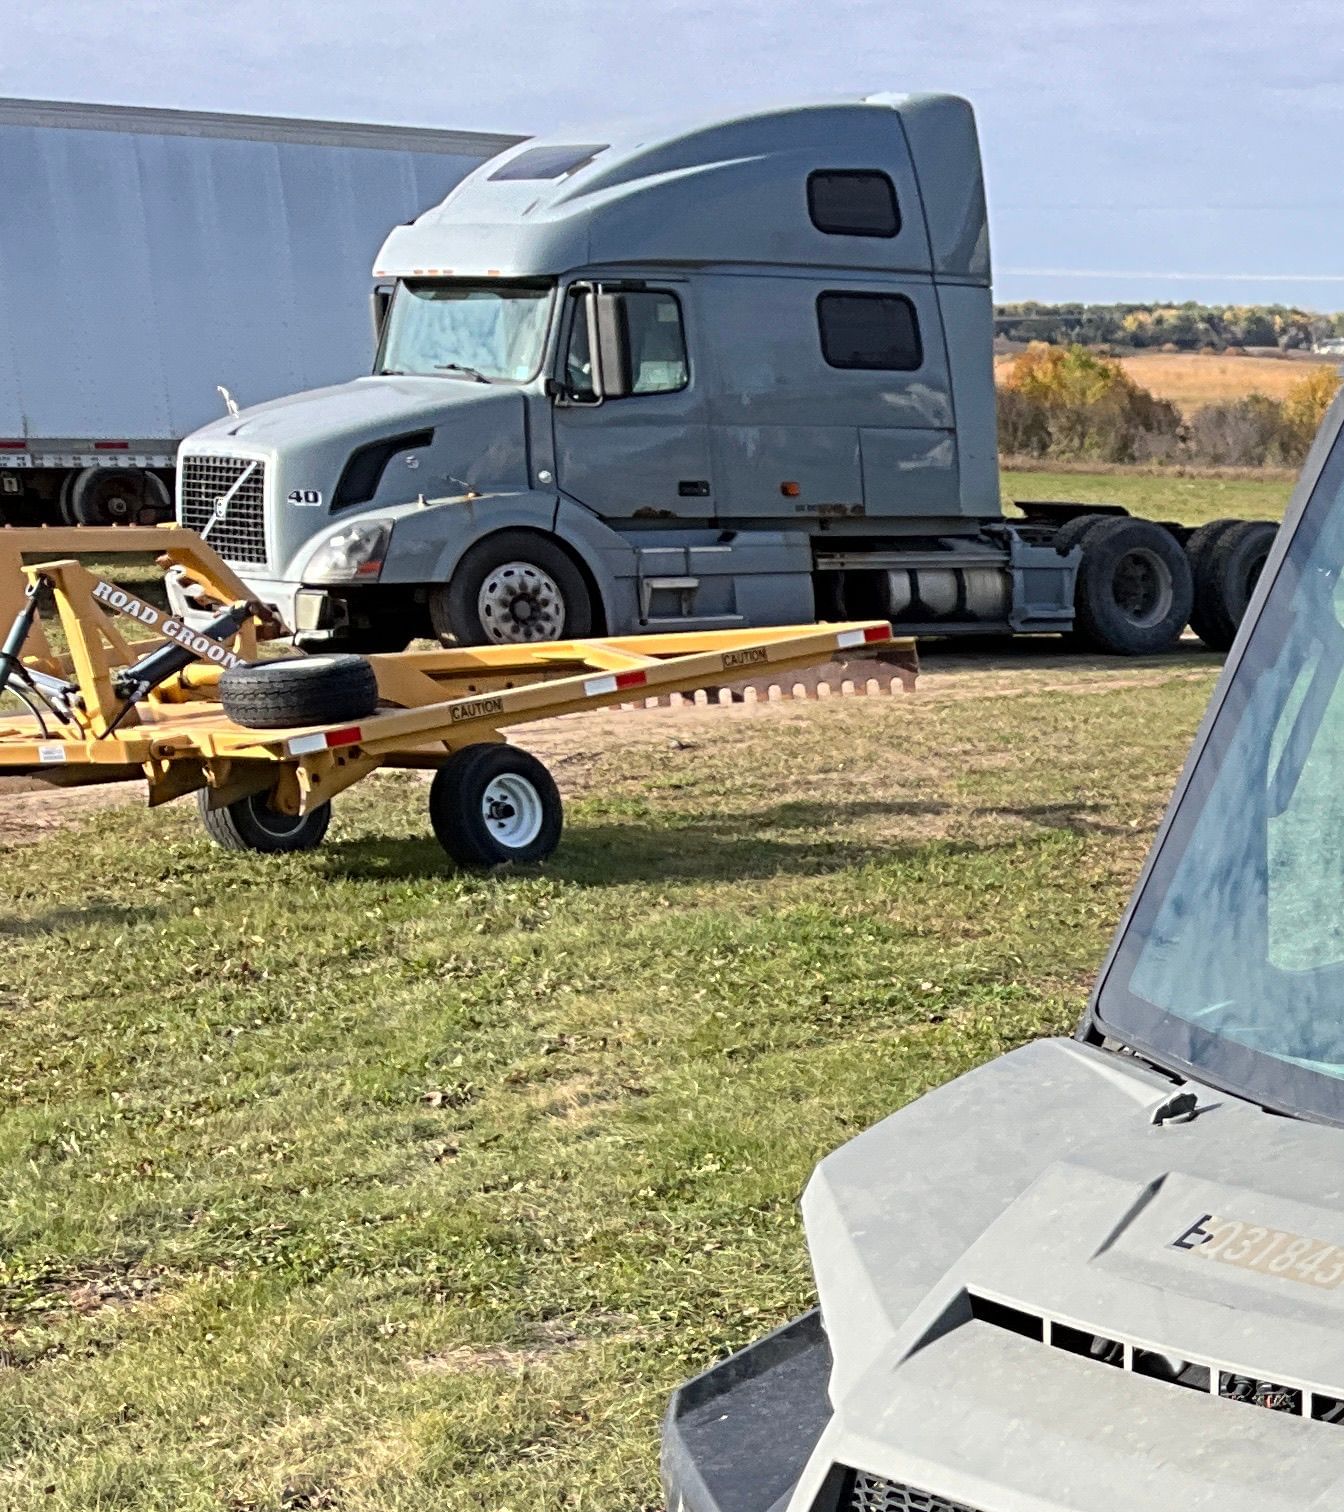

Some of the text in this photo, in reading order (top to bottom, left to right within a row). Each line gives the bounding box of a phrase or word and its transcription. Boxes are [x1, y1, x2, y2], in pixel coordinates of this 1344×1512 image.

[288, 490, 320, 505] 40
[92, 581, 159, 625] ROAD
[723, 647, 768, 666] CAUTION
[452, 699, 502, 719] CAUTION
